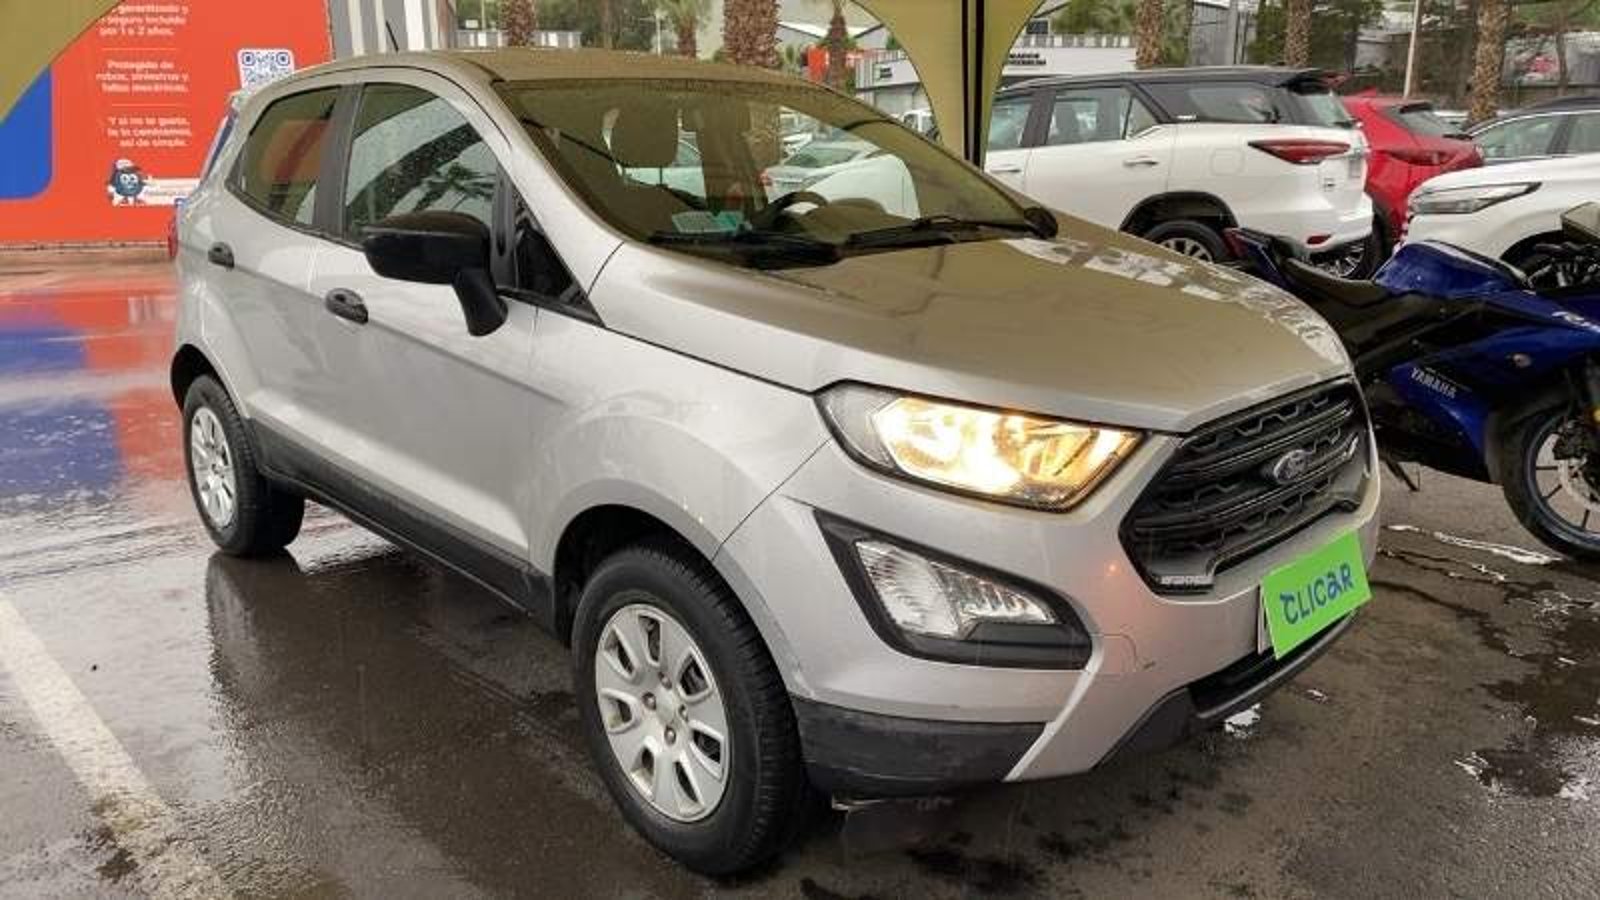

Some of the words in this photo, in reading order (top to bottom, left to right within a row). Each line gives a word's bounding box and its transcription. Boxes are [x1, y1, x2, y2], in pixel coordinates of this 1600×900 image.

[160, 60, 175, 69] de
[136, 138, 150, 147] de
[1411, 367, 1457, 400] YAMAHA
